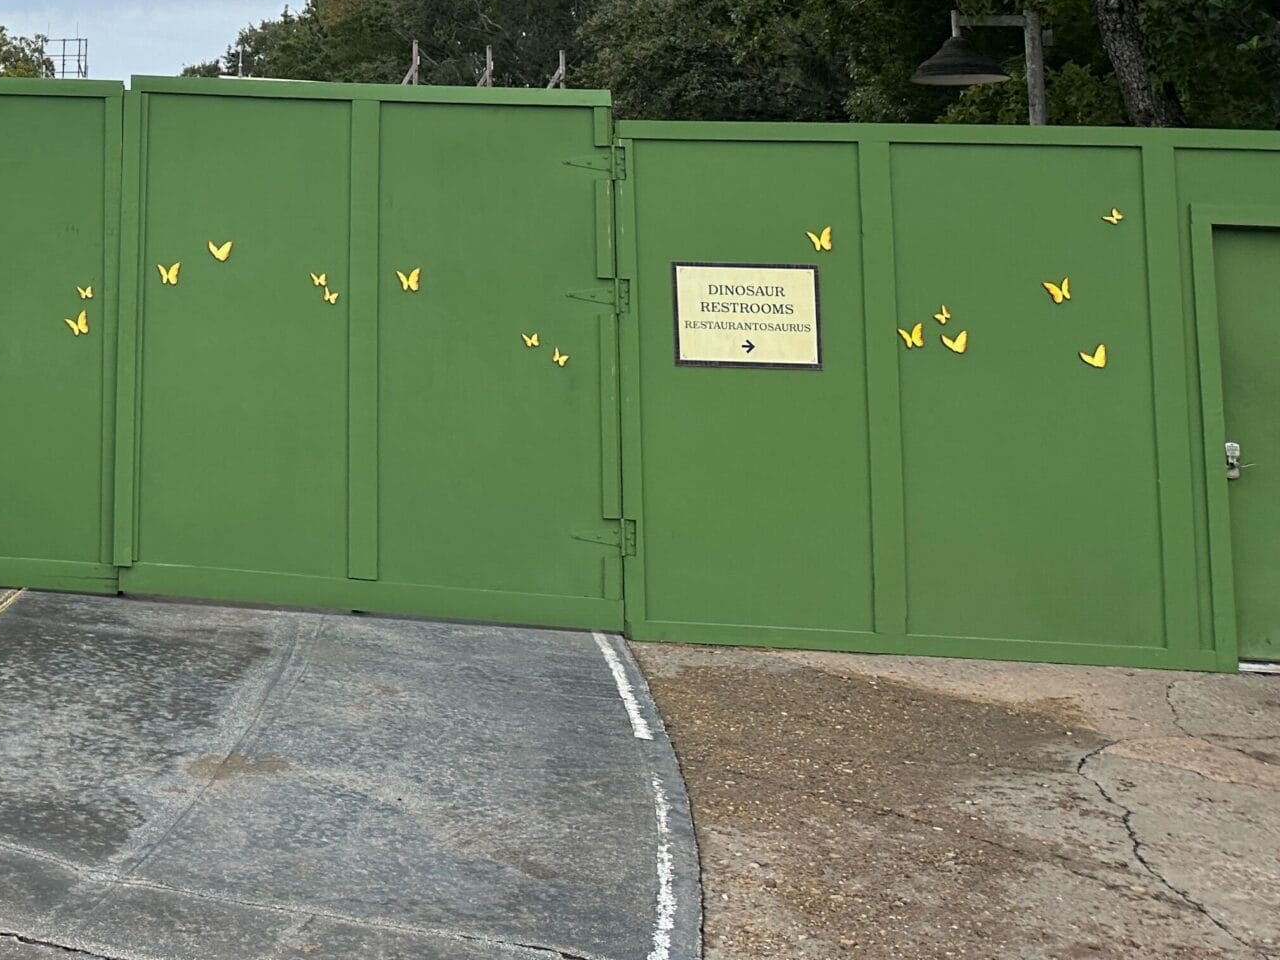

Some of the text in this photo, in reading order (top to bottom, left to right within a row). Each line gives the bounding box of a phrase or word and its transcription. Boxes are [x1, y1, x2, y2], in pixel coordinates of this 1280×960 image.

[708, 284, 786, 297] DINOSAUR
[700, 301, 794, 315] RESTROOMS
[684, 319, 812, 333] RESTAURANTOSAURUS
